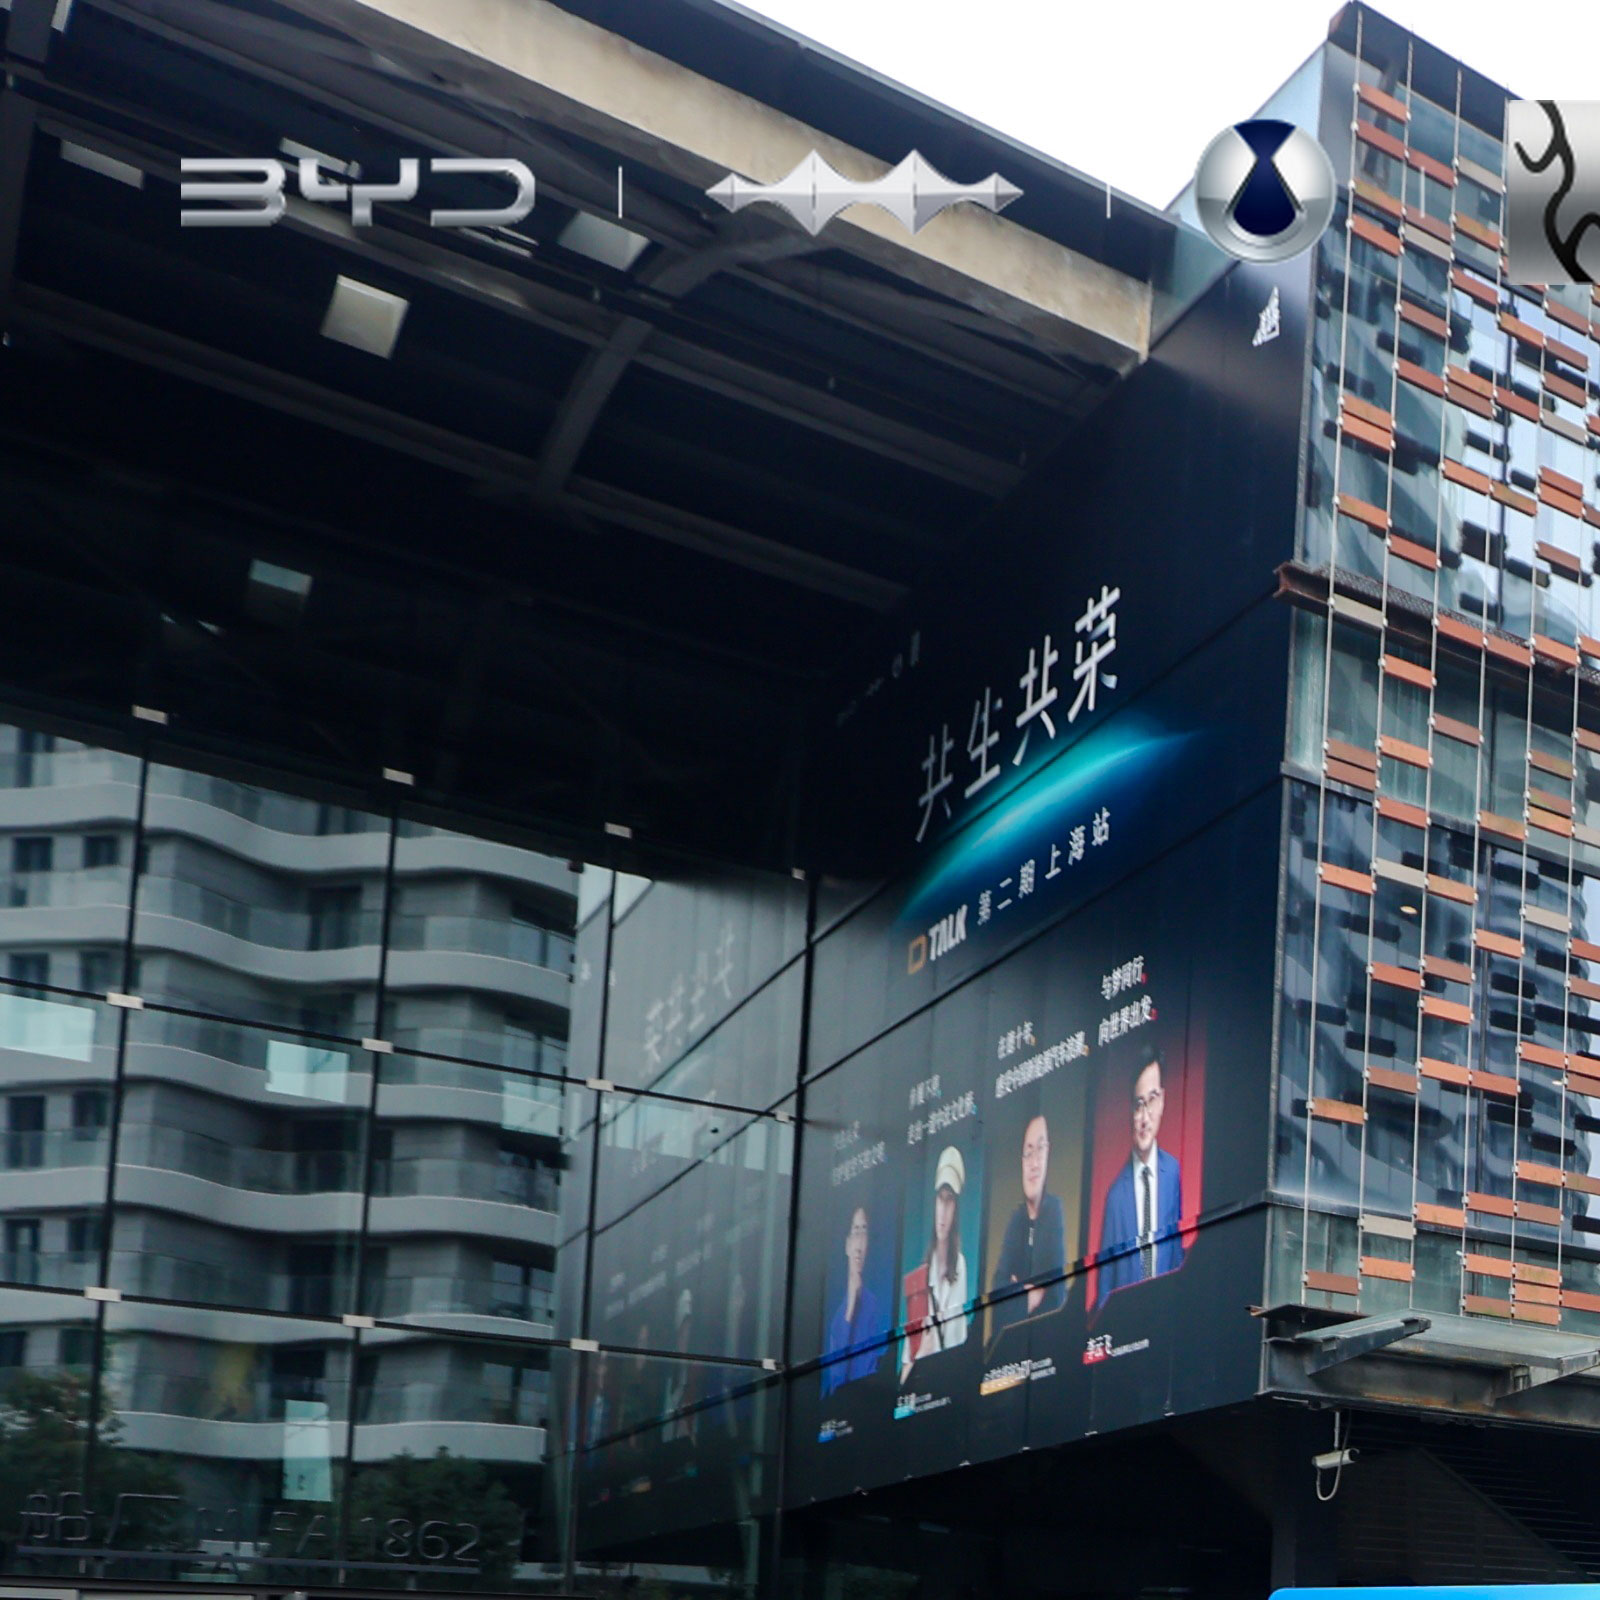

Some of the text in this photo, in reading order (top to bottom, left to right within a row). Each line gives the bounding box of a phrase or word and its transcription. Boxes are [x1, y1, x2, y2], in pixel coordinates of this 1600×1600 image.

[915, 585, 1121, 843] 共生共荣
[928, 904, 969, 962] TALK
[358, 1514, 483, 1563] 1862
